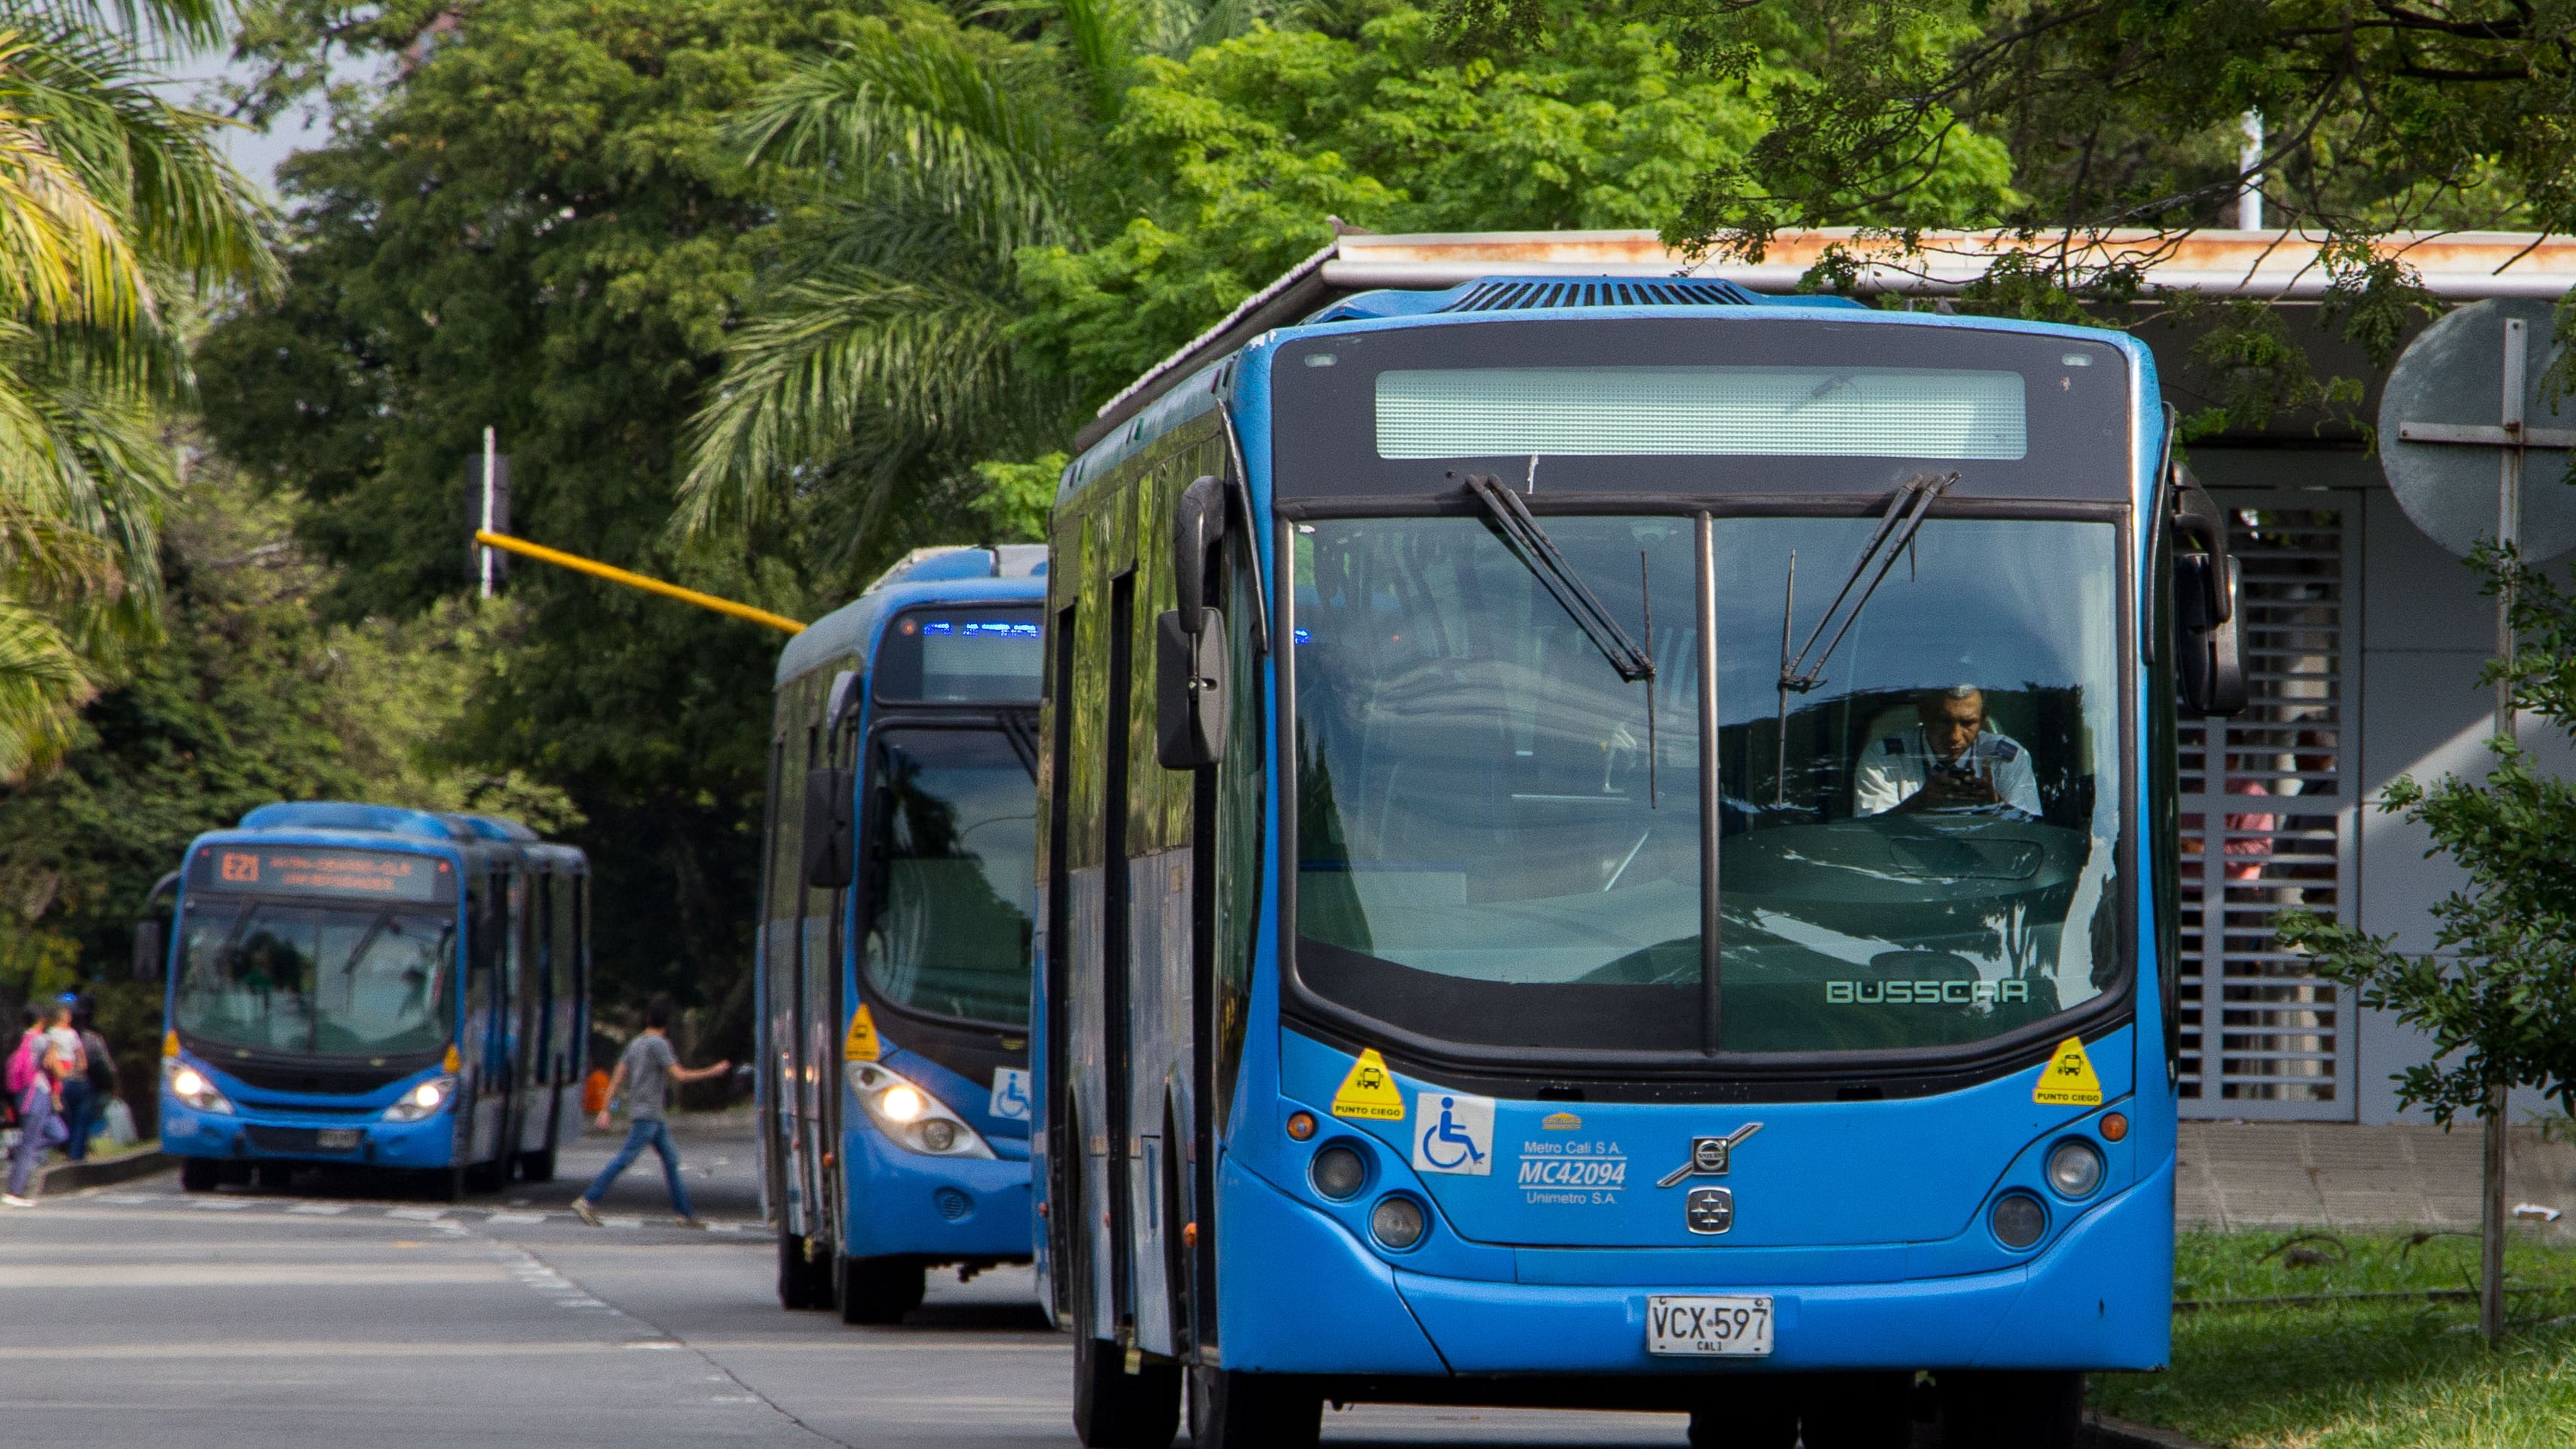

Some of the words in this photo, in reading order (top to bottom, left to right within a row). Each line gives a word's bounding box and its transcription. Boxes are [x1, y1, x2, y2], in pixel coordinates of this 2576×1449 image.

[1826, 980, 2029, 1004] BUSSCAR
[2038, 1092, 2069, 1101] PUNTO
[2072, 1094, 2100, 1102] CIEGO
[1335, 1105, 1368, 1115] PUNTO
[1371, 1107, 1401, 1117] CIEGO
[1524, 1141, 1562, 1153] Metro
[1566, 1141, 1591, 1154] Cali
[1518, 1161, 1627, 1184] MC42094
[1527, 1191, 1587, 1204] Unimetro
[1698, 1340, 1722, 1351] CALI
